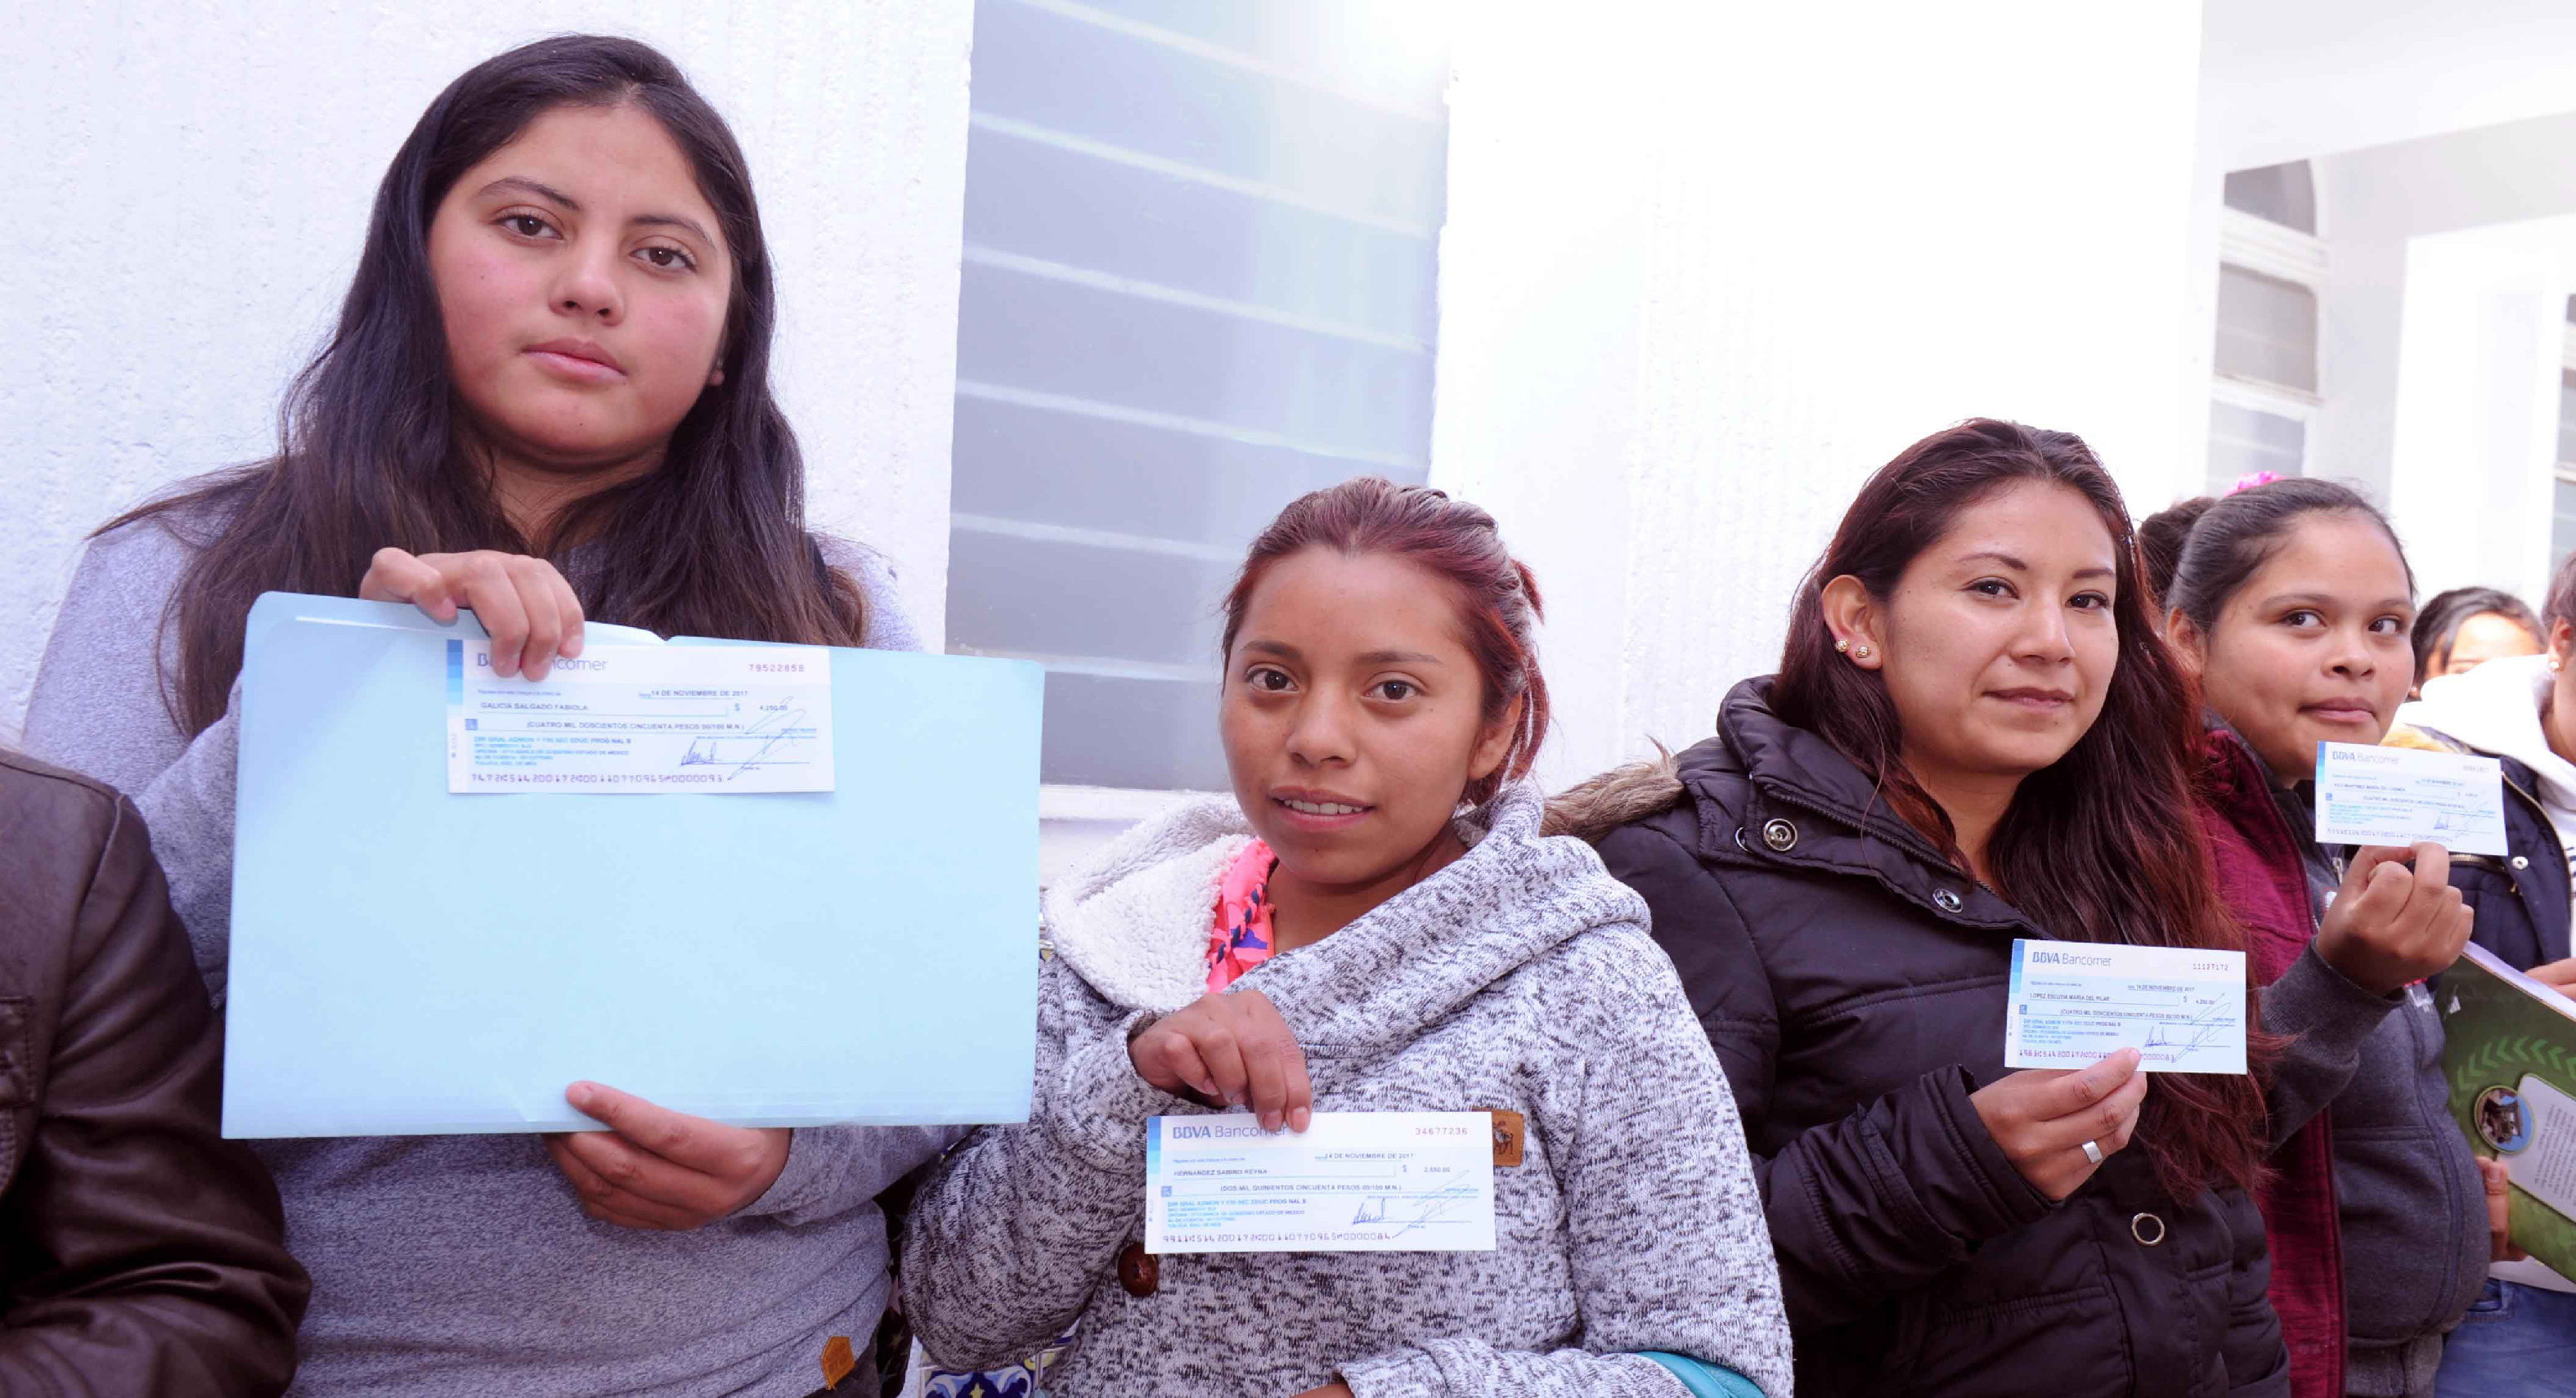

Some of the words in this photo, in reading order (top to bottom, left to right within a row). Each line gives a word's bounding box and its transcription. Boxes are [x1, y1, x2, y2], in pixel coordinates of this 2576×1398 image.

[551, 657, 608, 670] comer
[2032, 952, 2061, 964] BBVA
[2062, 952, 2112, 967] Bancomer
[1173, 1126, 1211, 1139] BBVA
[1416, 1127, 1468, 1136] 34677236
